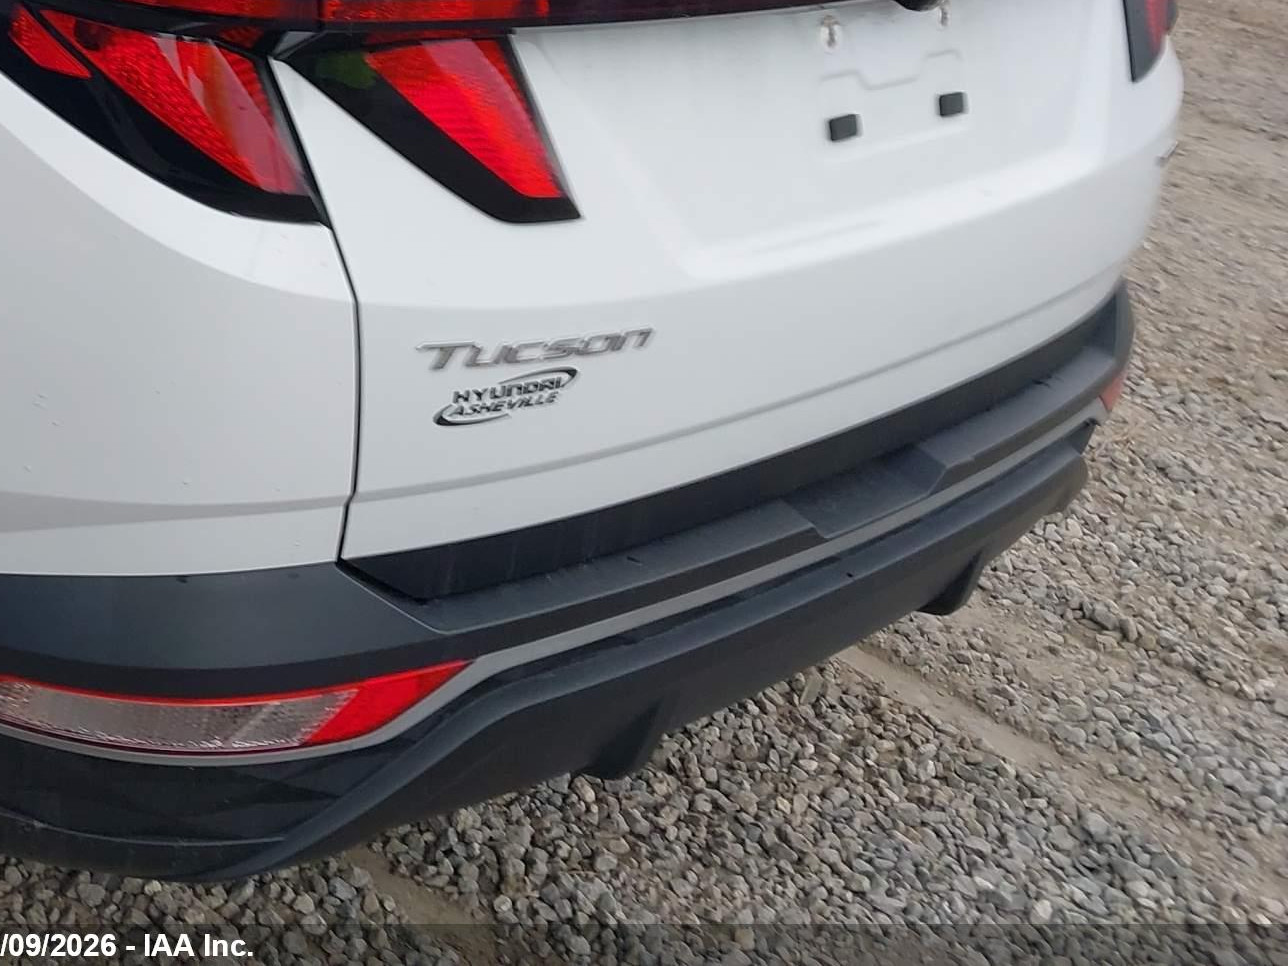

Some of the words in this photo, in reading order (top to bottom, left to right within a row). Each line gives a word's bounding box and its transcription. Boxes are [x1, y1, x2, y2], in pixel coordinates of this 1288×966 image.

[416, 327, 655, 371] TUCSON
[447, 390, 560, 417] ASHEVILLE
[452, 376, 563, 404] HYUNDAI
